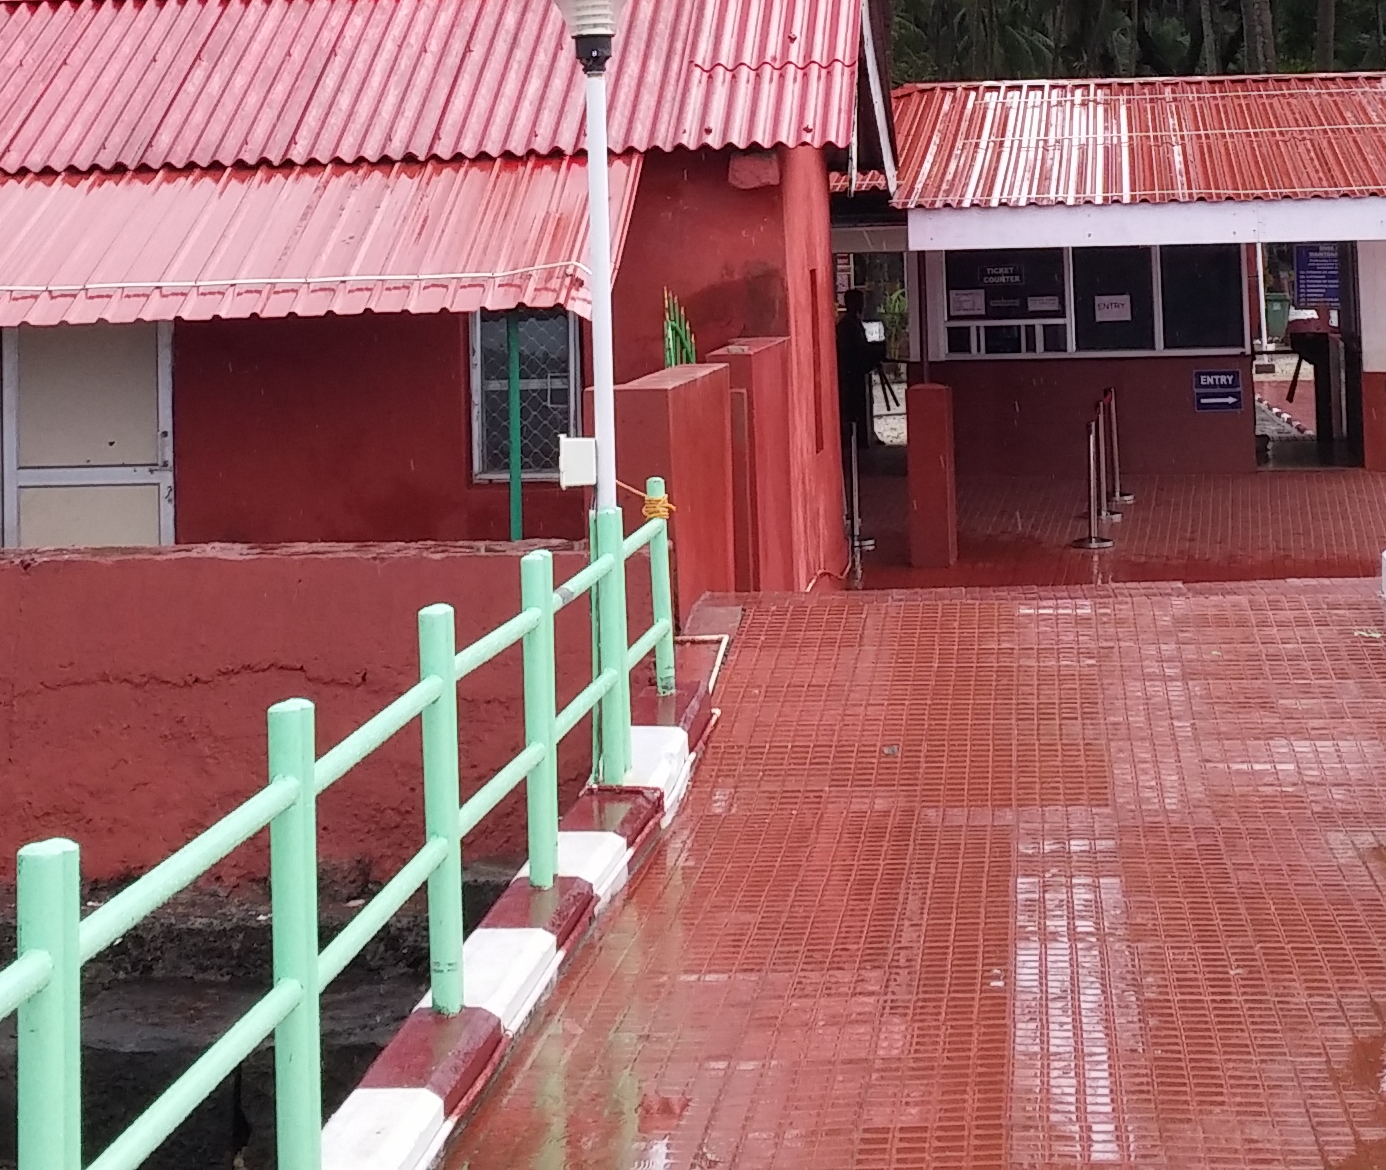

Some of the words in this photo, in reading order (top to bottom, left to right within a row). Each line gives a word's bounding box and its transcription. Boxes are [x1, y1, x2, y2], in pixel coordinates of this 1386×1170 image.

[986, 266, 1014, 275] TICKET
[983, 275, 1021, 284] COUNTER
[1097, 302, 1126, 311] ENTRY
[1200, 375, 1234, 385] ENTRY
